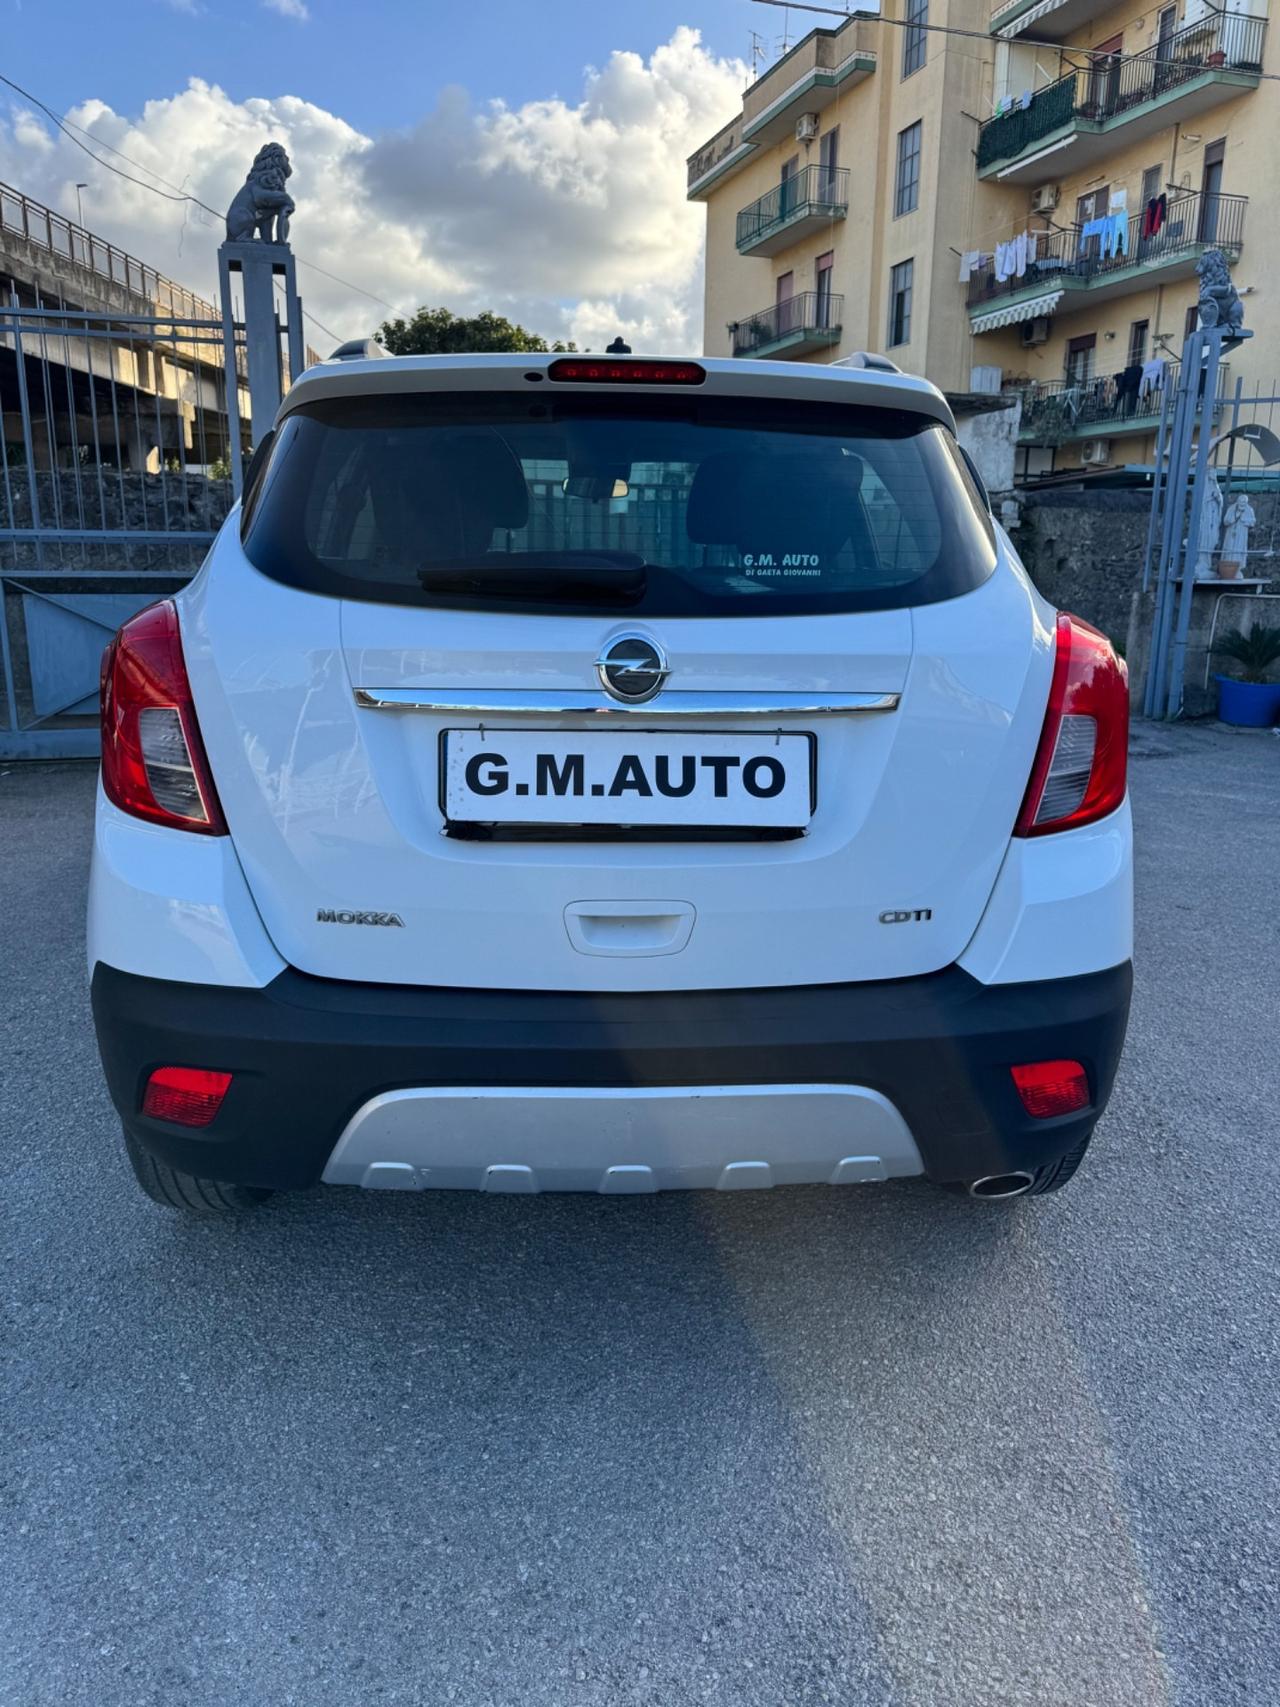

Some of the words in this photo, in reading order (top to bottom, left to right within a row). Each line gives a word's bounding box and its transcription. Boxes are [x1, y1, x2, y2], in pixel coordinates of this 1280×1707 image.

[744, 554, 777, 566] G.M.
[782, 554, 819, 566] AUTO
[465, 752, 786, 798] G.M.AUTO
[317, 908, 405, 928] MOKKA
[879, 908, 932, 924] CDTI
